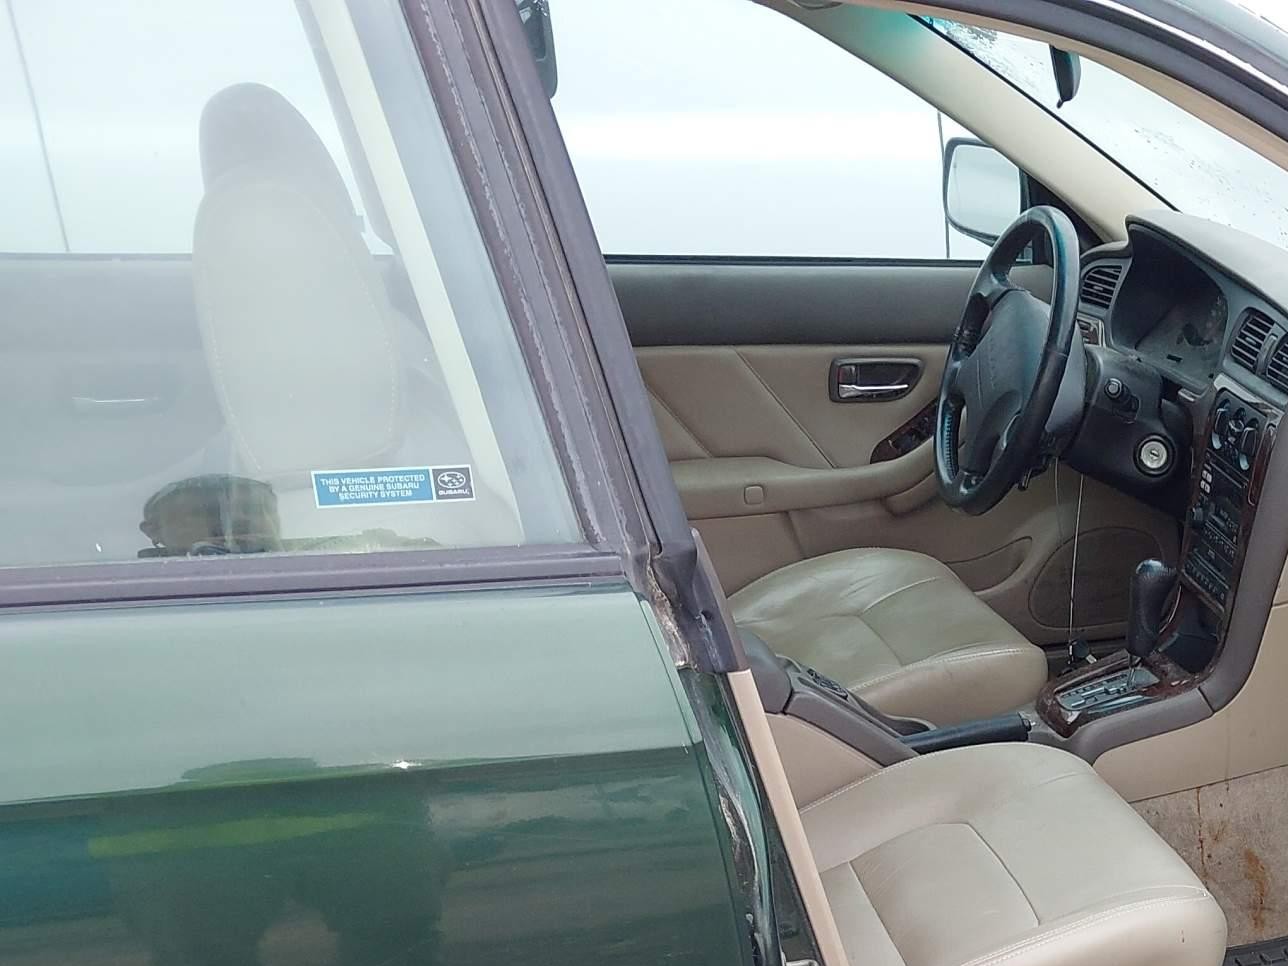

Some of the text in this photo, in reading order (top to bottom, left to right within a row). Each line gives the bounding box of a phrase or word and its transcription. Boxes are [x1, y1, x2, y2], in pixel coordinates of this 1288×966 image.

[320, 474, 425, 486] THIS VEHICLE PROTECTED
[328, 481, 420, 493] BY A GENUINE SUBARU
[438, 488, 467, 496] SUBARU
[339, 489, 413, 500] SECURITY SYSTEM
